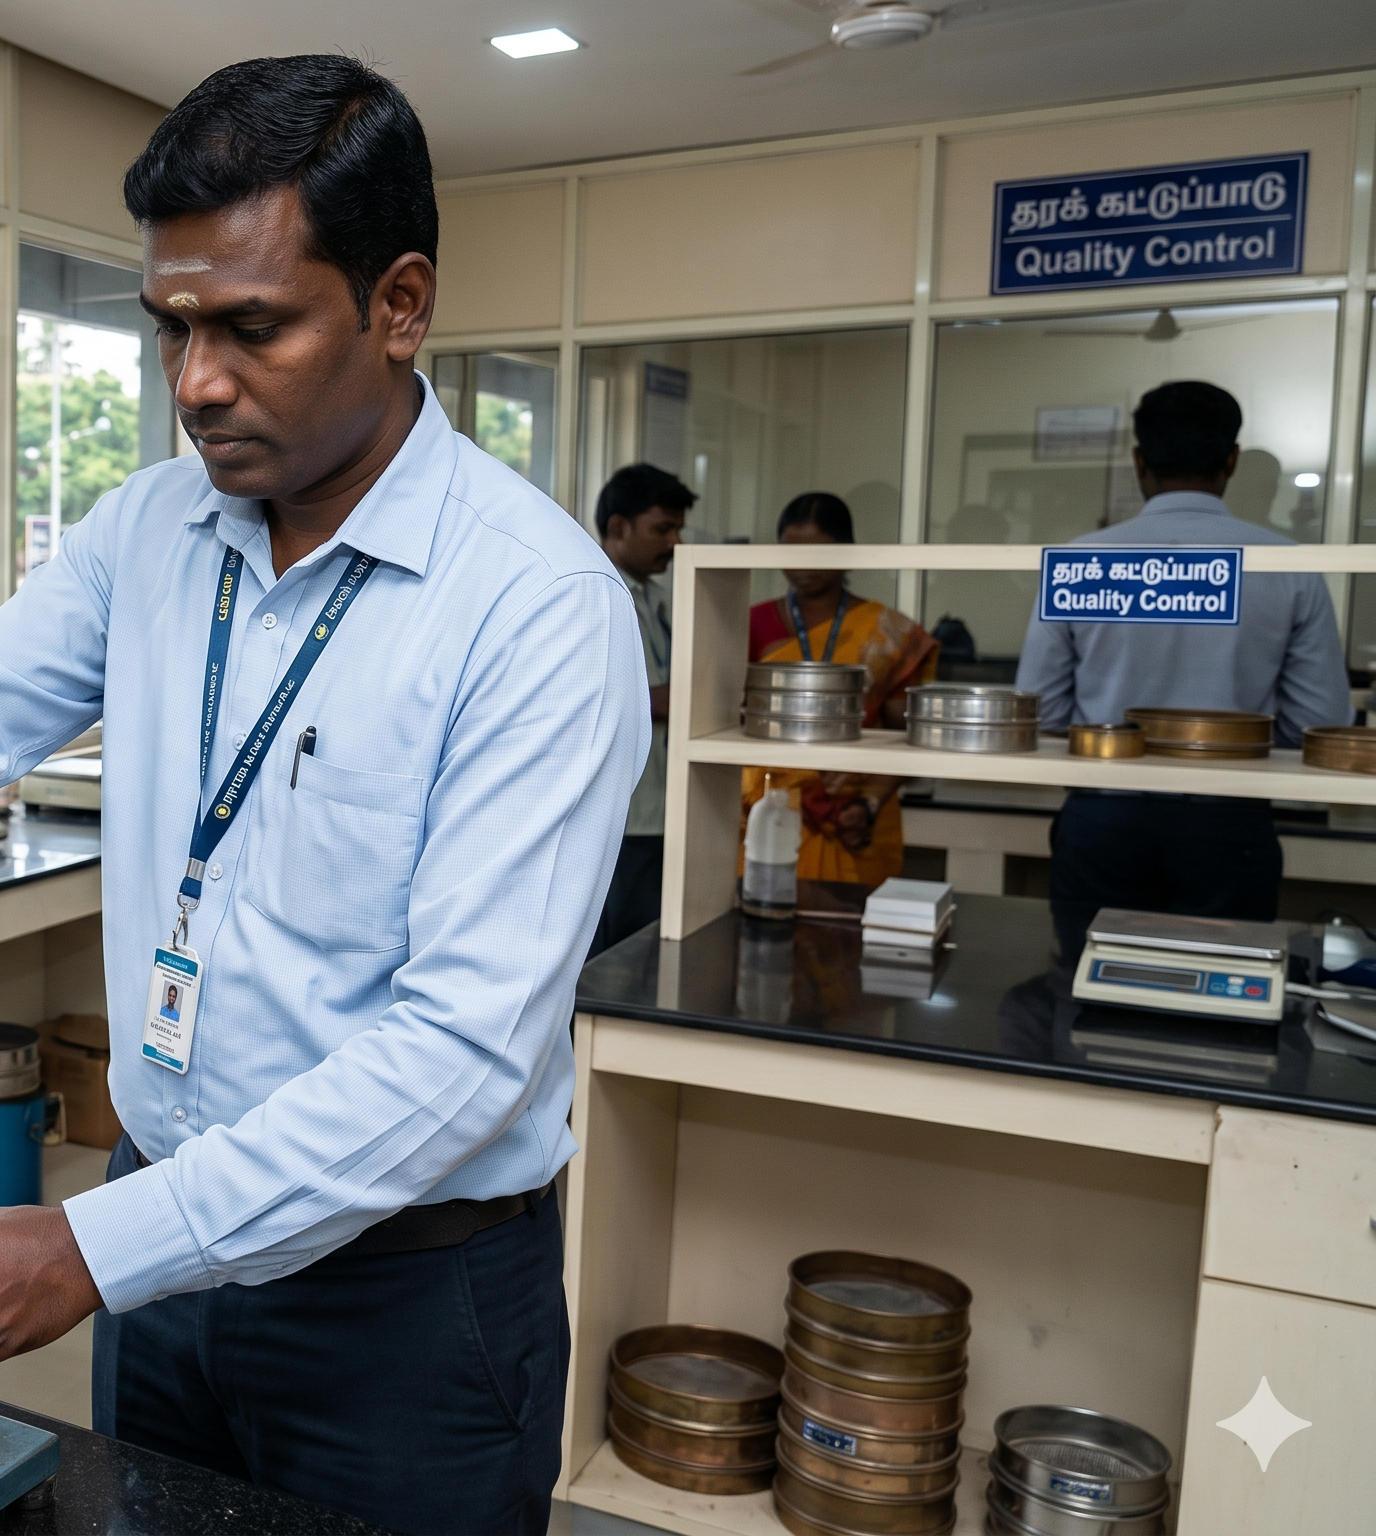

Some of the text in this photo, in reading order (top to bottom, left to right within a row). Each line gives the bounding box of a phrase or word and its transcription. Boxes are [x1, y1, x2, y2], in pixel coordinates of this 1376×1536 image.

[1009, 172, 1286, 234] தரக் கட்டுப்பாடு
[1015, 227, 1275, 277] Quality Control
[1052, 556, 1230, 587] தரக் கட்டுப்பாடு
[1052, 588, 1227, 616] Quality Control
